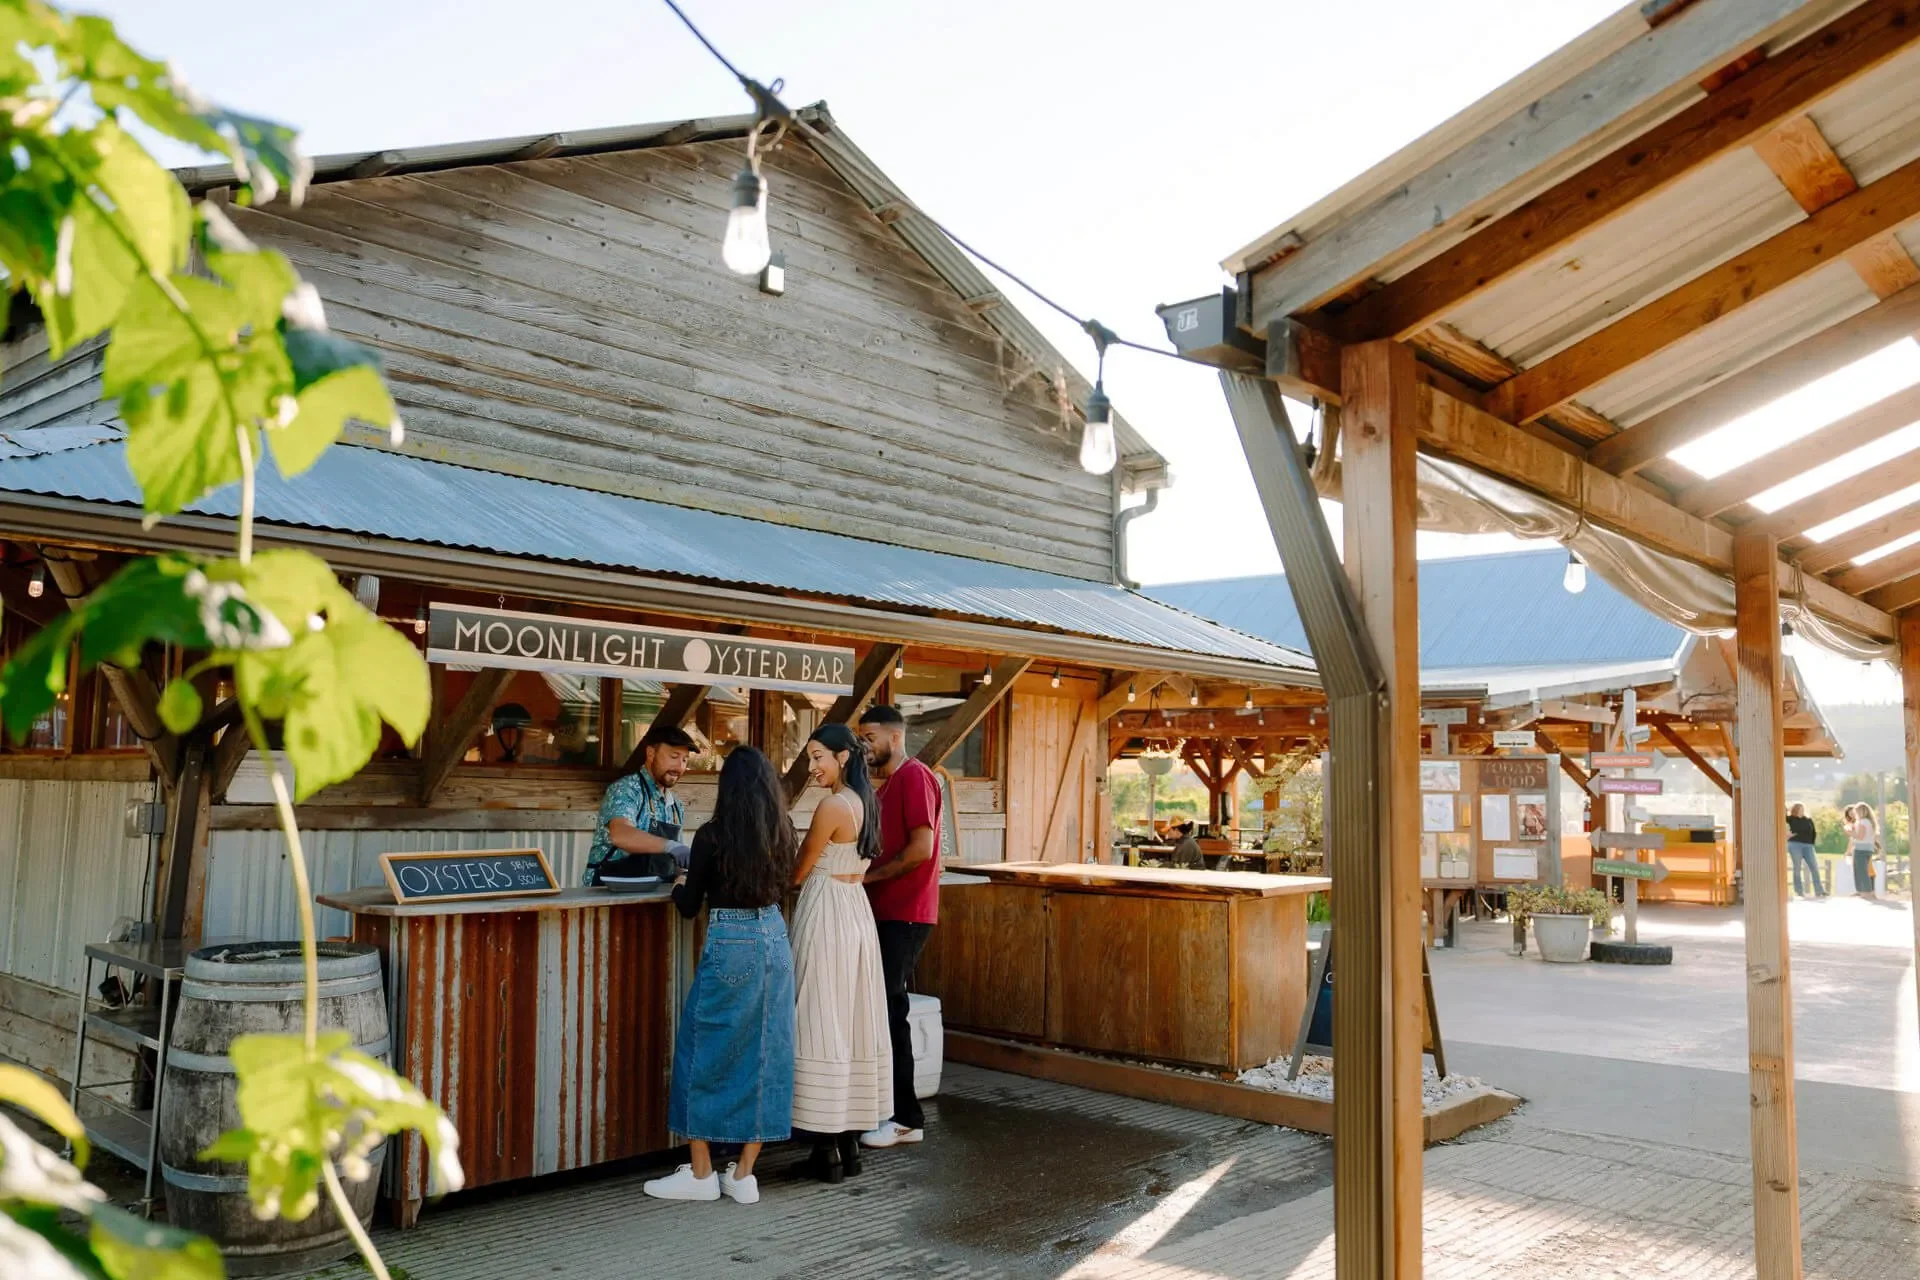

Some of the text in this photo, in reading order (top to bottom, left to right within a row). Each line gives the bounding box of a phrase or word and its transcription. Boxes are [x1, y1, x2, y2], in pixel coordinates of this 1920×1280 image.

[454, 617, 844, 685] MOONLIGHT OYSTER BAR
[400, 861, 512, 893] OYSTERS
